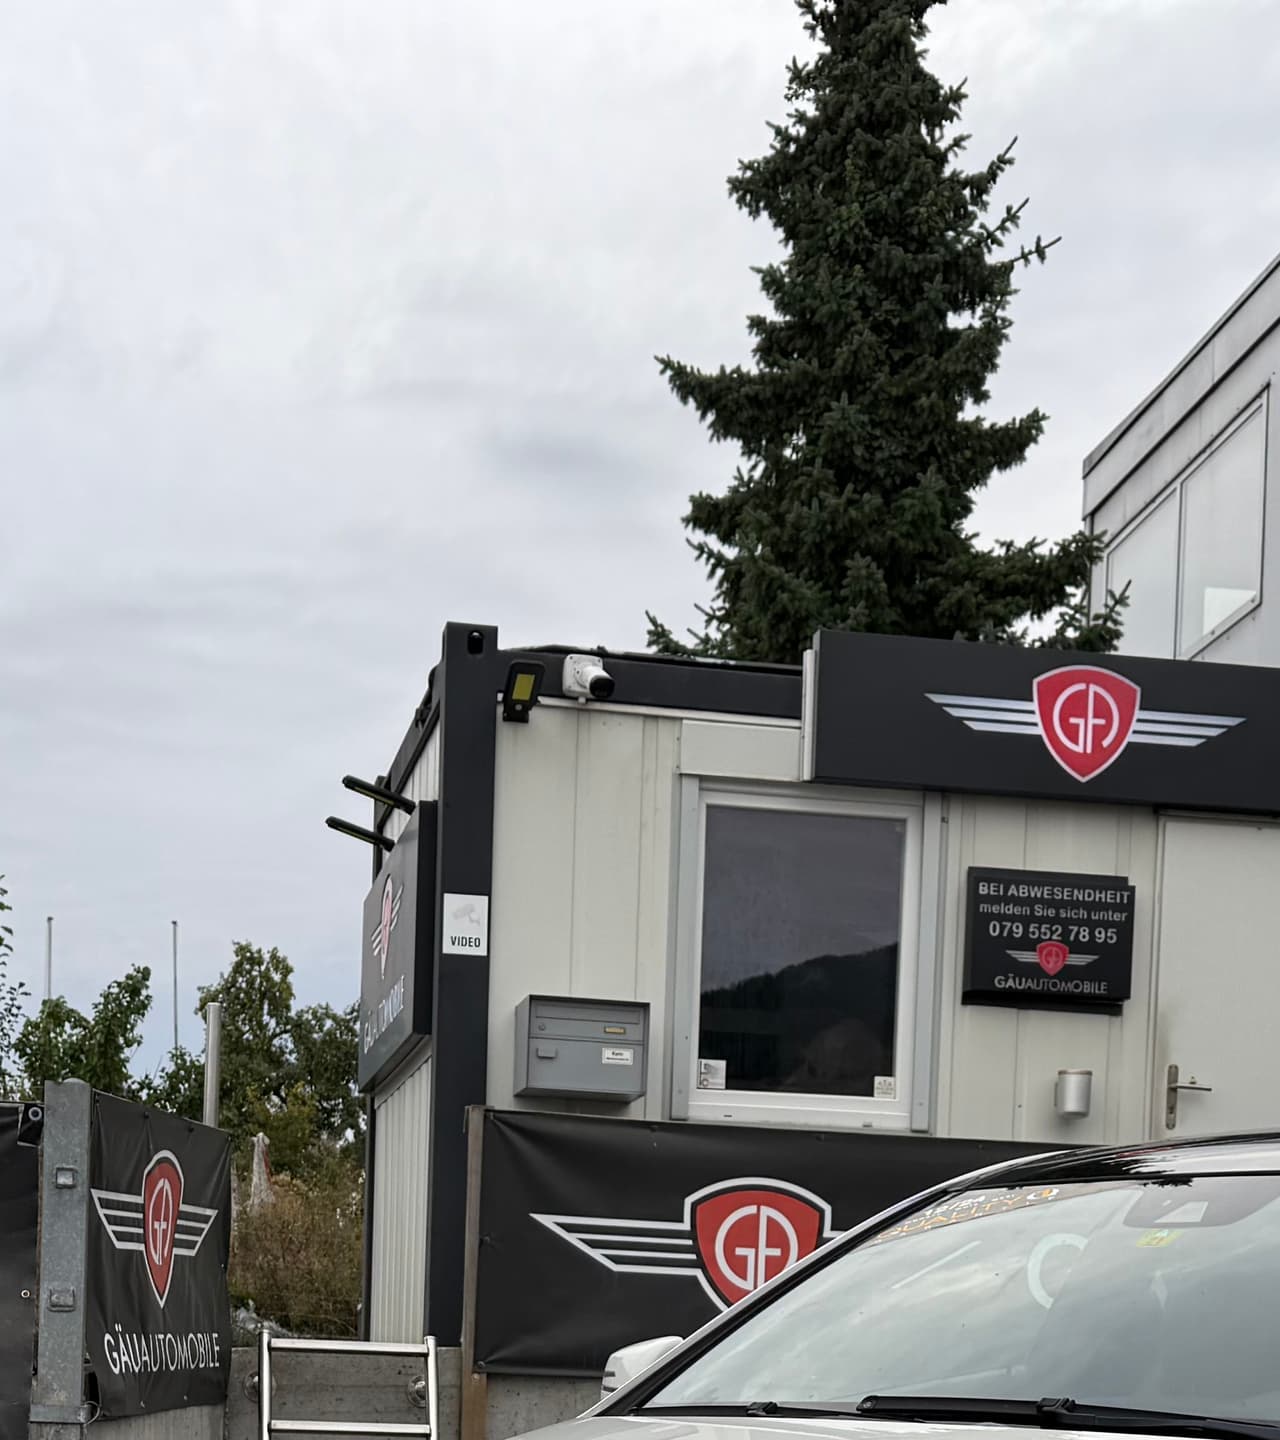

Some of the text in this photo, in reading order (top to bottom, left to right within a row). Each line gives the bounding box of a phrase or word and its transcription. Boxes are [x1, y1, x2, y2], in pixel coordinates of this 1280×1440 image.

[978, 881, 1131, 904] BEI ABWESENDHEIT
[979, 902, 1128, 922] melden Sie sich unter
[450, 935, 481, 949] VIDEO
[988, 920, 1118, 944] 079 552 78 95
[994, 973, 1108, 994] GÄUAUTOMOBILE
[104, 1323, 220, 1375] GÄUAUTOMOBILE
